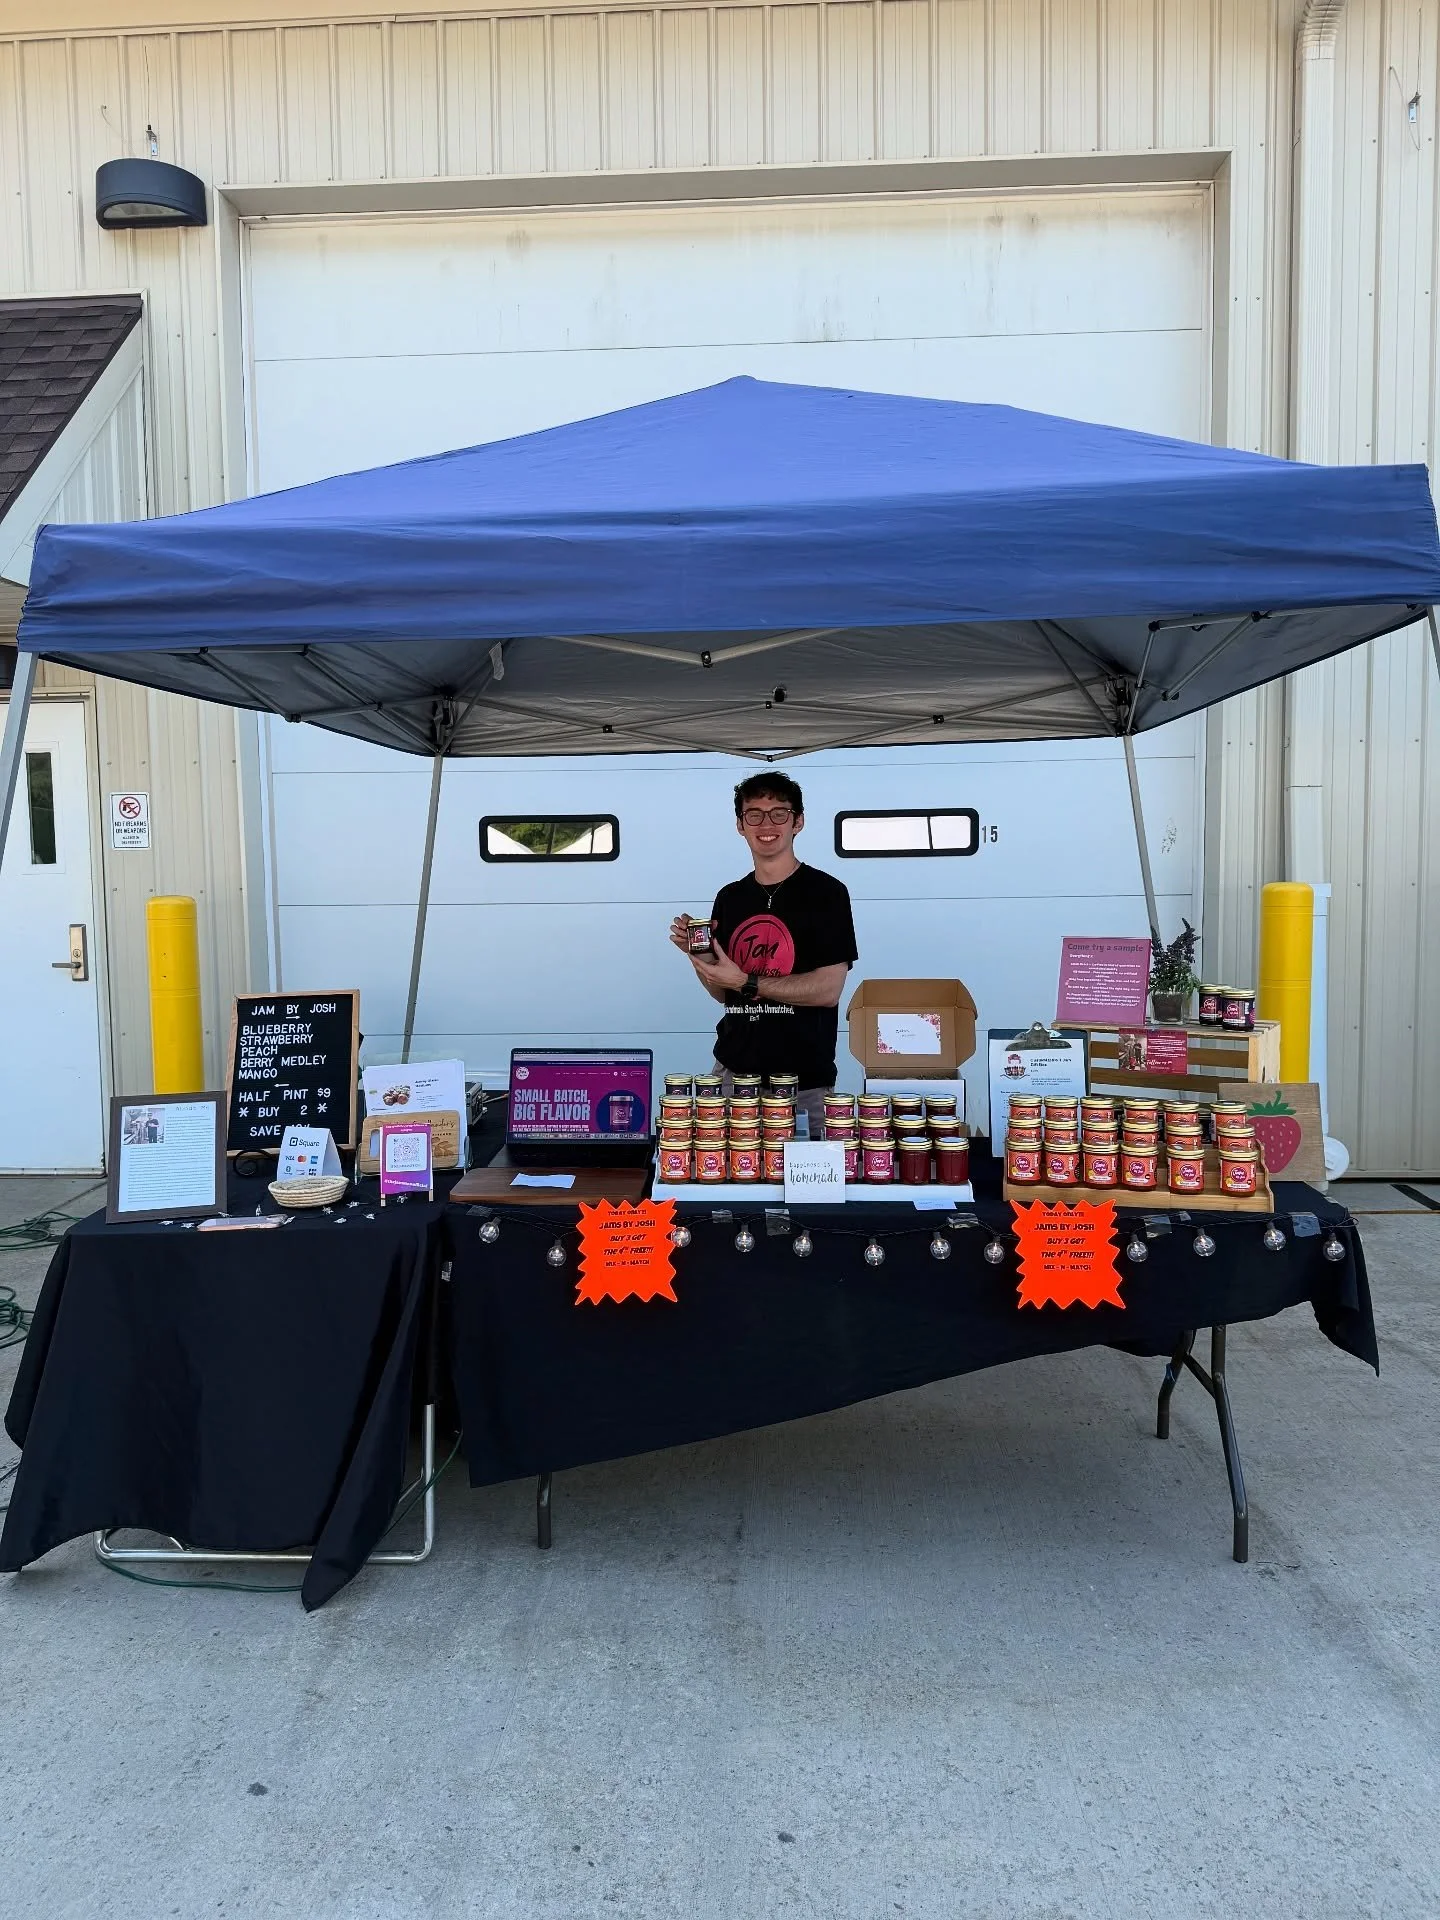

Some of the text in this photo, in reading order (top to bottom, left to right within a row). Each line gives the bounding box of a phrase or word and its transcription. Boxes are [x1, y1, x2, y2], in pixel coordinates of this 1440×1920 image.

[982, 825, 998, 843] 15
[1092, 943, 1105, 952] try
[1113, 944, 1144, 953] sample
[251, 1003, 336, 1016] JAM BY JOSH
[242, 1023, 312, 1036] BLUEBERRY
[239, 1034, 314, 1047] STRAWBERRY
[241, 1045, 278, 1057] PEACH
[240, 1054, 327, 1069] BERRY MEDLEY
[238, 1068, 278, 1080] MANGO
[238, 1087, 331, 1102] HALF PINT $9
[514, 1089, 591, 1104] SMALL BATCH,
[257, 1105, 308, 1118] BUY 2
[513, 1103, 591, 1121] BIG FLAVOR
[249, 1124, 281, 1137] SAVE
[298, 1139, 320, 1147] Square
[790, 1168, 839, 1185] homemade
[598, 1220, 655, 1229] JAMS BY JOSH
[1034, 1223, 1095, 1231] JAMS BY JOSH
